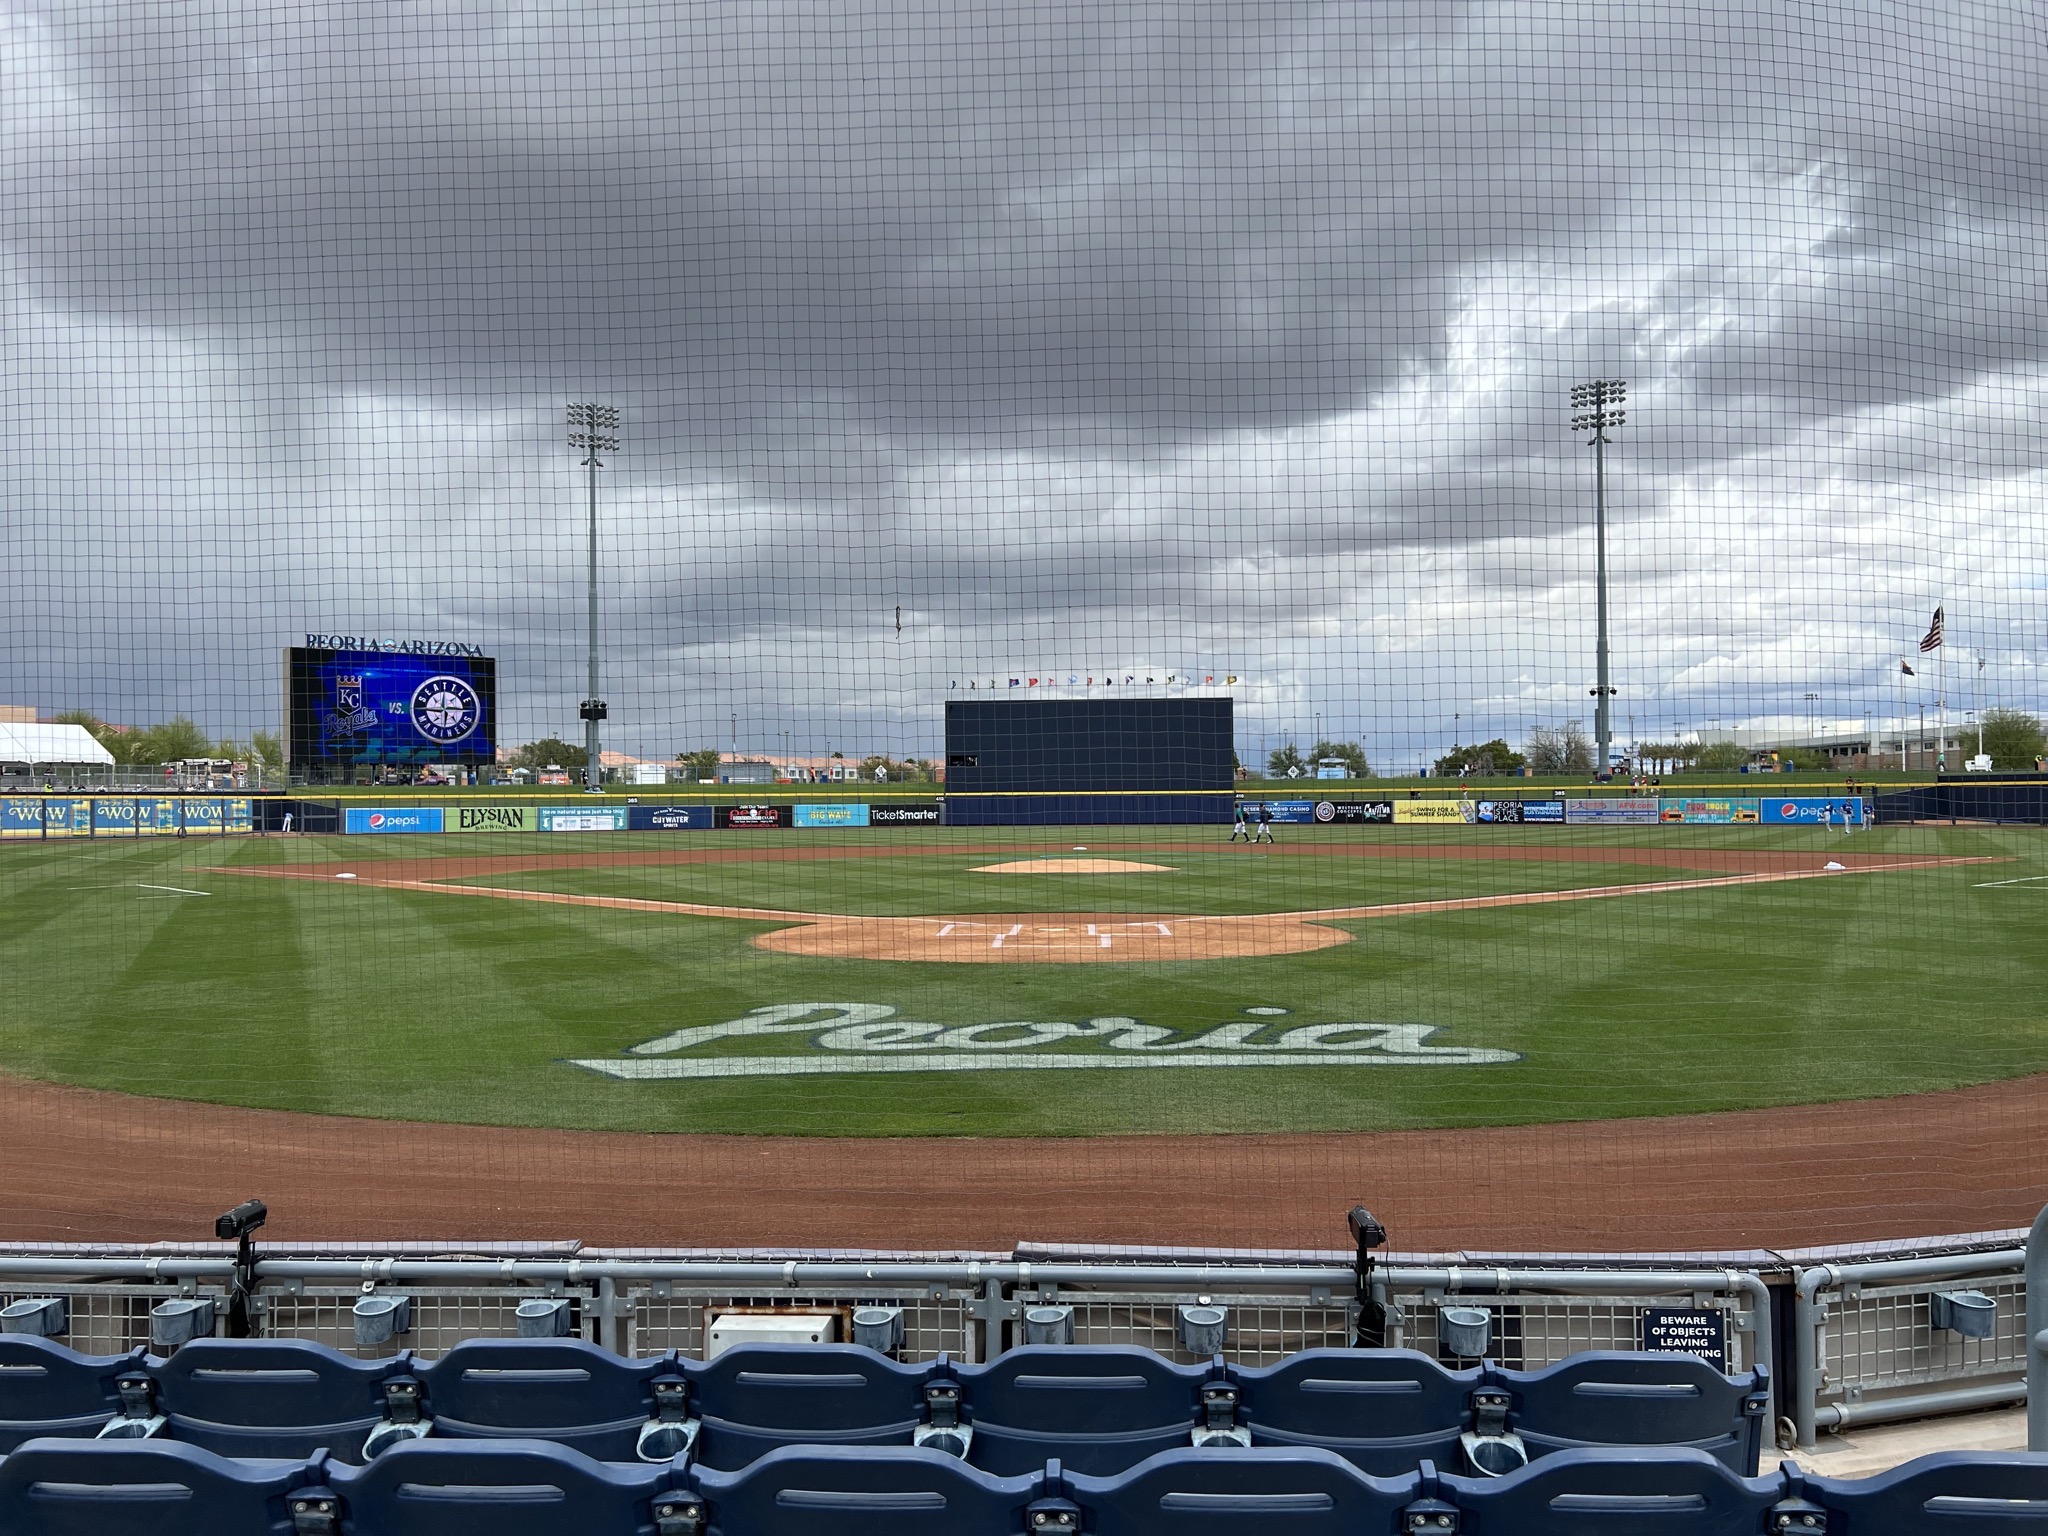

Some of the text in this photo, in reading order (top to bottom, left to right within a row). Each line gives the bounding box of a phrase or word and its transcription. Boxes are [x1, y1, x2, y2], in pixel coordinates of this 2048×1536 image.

[306, 633, 483, 657] PEORIA ARIZONA
[340, 689, 359, 708] KC
[418, 682, 472, 703] SEATTLE
[389, 702, 404, 714] VS.
[324, 707, 378, 737] Royals
[418, 715, 472, 737] MARINERS
[178, 805, 227, 819] WOW
[1493, 801, 1523, 809] PEORIA
[1800, 807, 1837, 817] pepi
[8, 806, 66, 821] WOW
[97, 806, 150, 820] WOW
[460, 808, 523, 829] ELYSIAN
[810, 811, 852, 819] BIG WAVE
[871, 810, 939, 820] TicketSmarter
[387, 816, 420, 827] pepsi
[568, 1001, 1523, 1078] Peoria
[1651, 1327, 1716, 1337] OF OBJECTS
[1661, 1338, 1708, 1346] LEAVING
